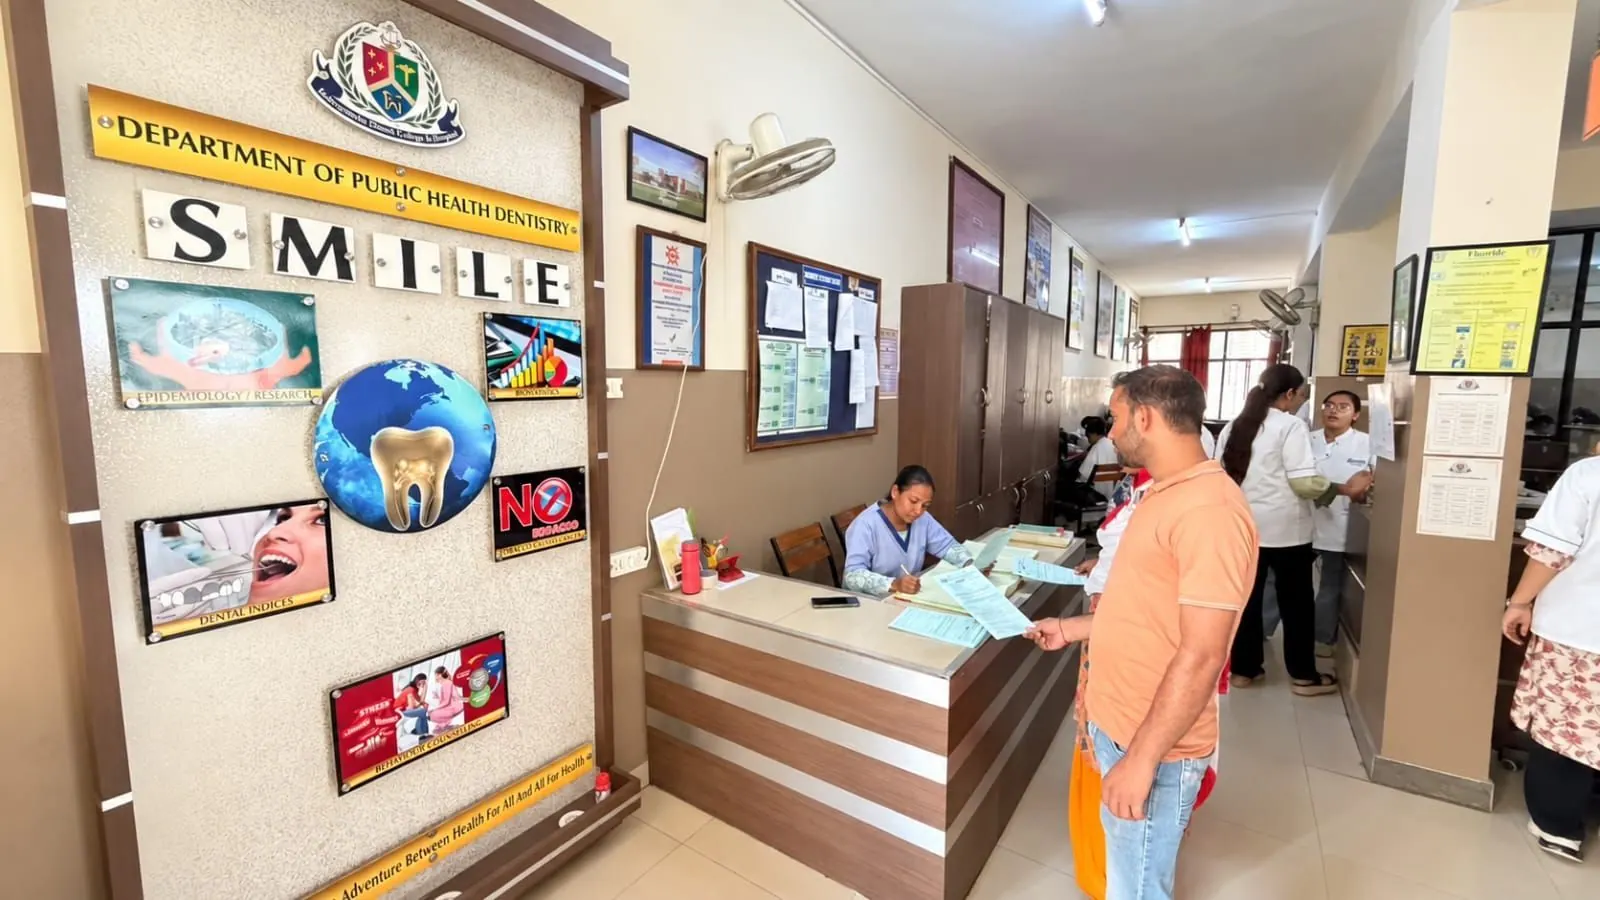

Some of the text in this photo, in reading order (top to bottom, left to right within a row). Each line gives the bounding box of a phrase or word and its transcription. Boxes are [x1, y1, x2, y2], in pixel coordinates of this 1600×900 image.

[117, 115, 570, 236] DEPARTMENT OF PUBLIC HEALTH DENTISTRY
[137, 390, 242, 403] EPIDEMIOLOGY
[254, 389, 313, 400] RESEARCH
[199, 596, 294, 625] DENTAL INDICES
[374, 745, 426, 774] BEHAVIOUR
[426, 719, 483, 749] COUNSELLING
[341, 756, 585, 900] Adventure Between Health For All And All For Health
